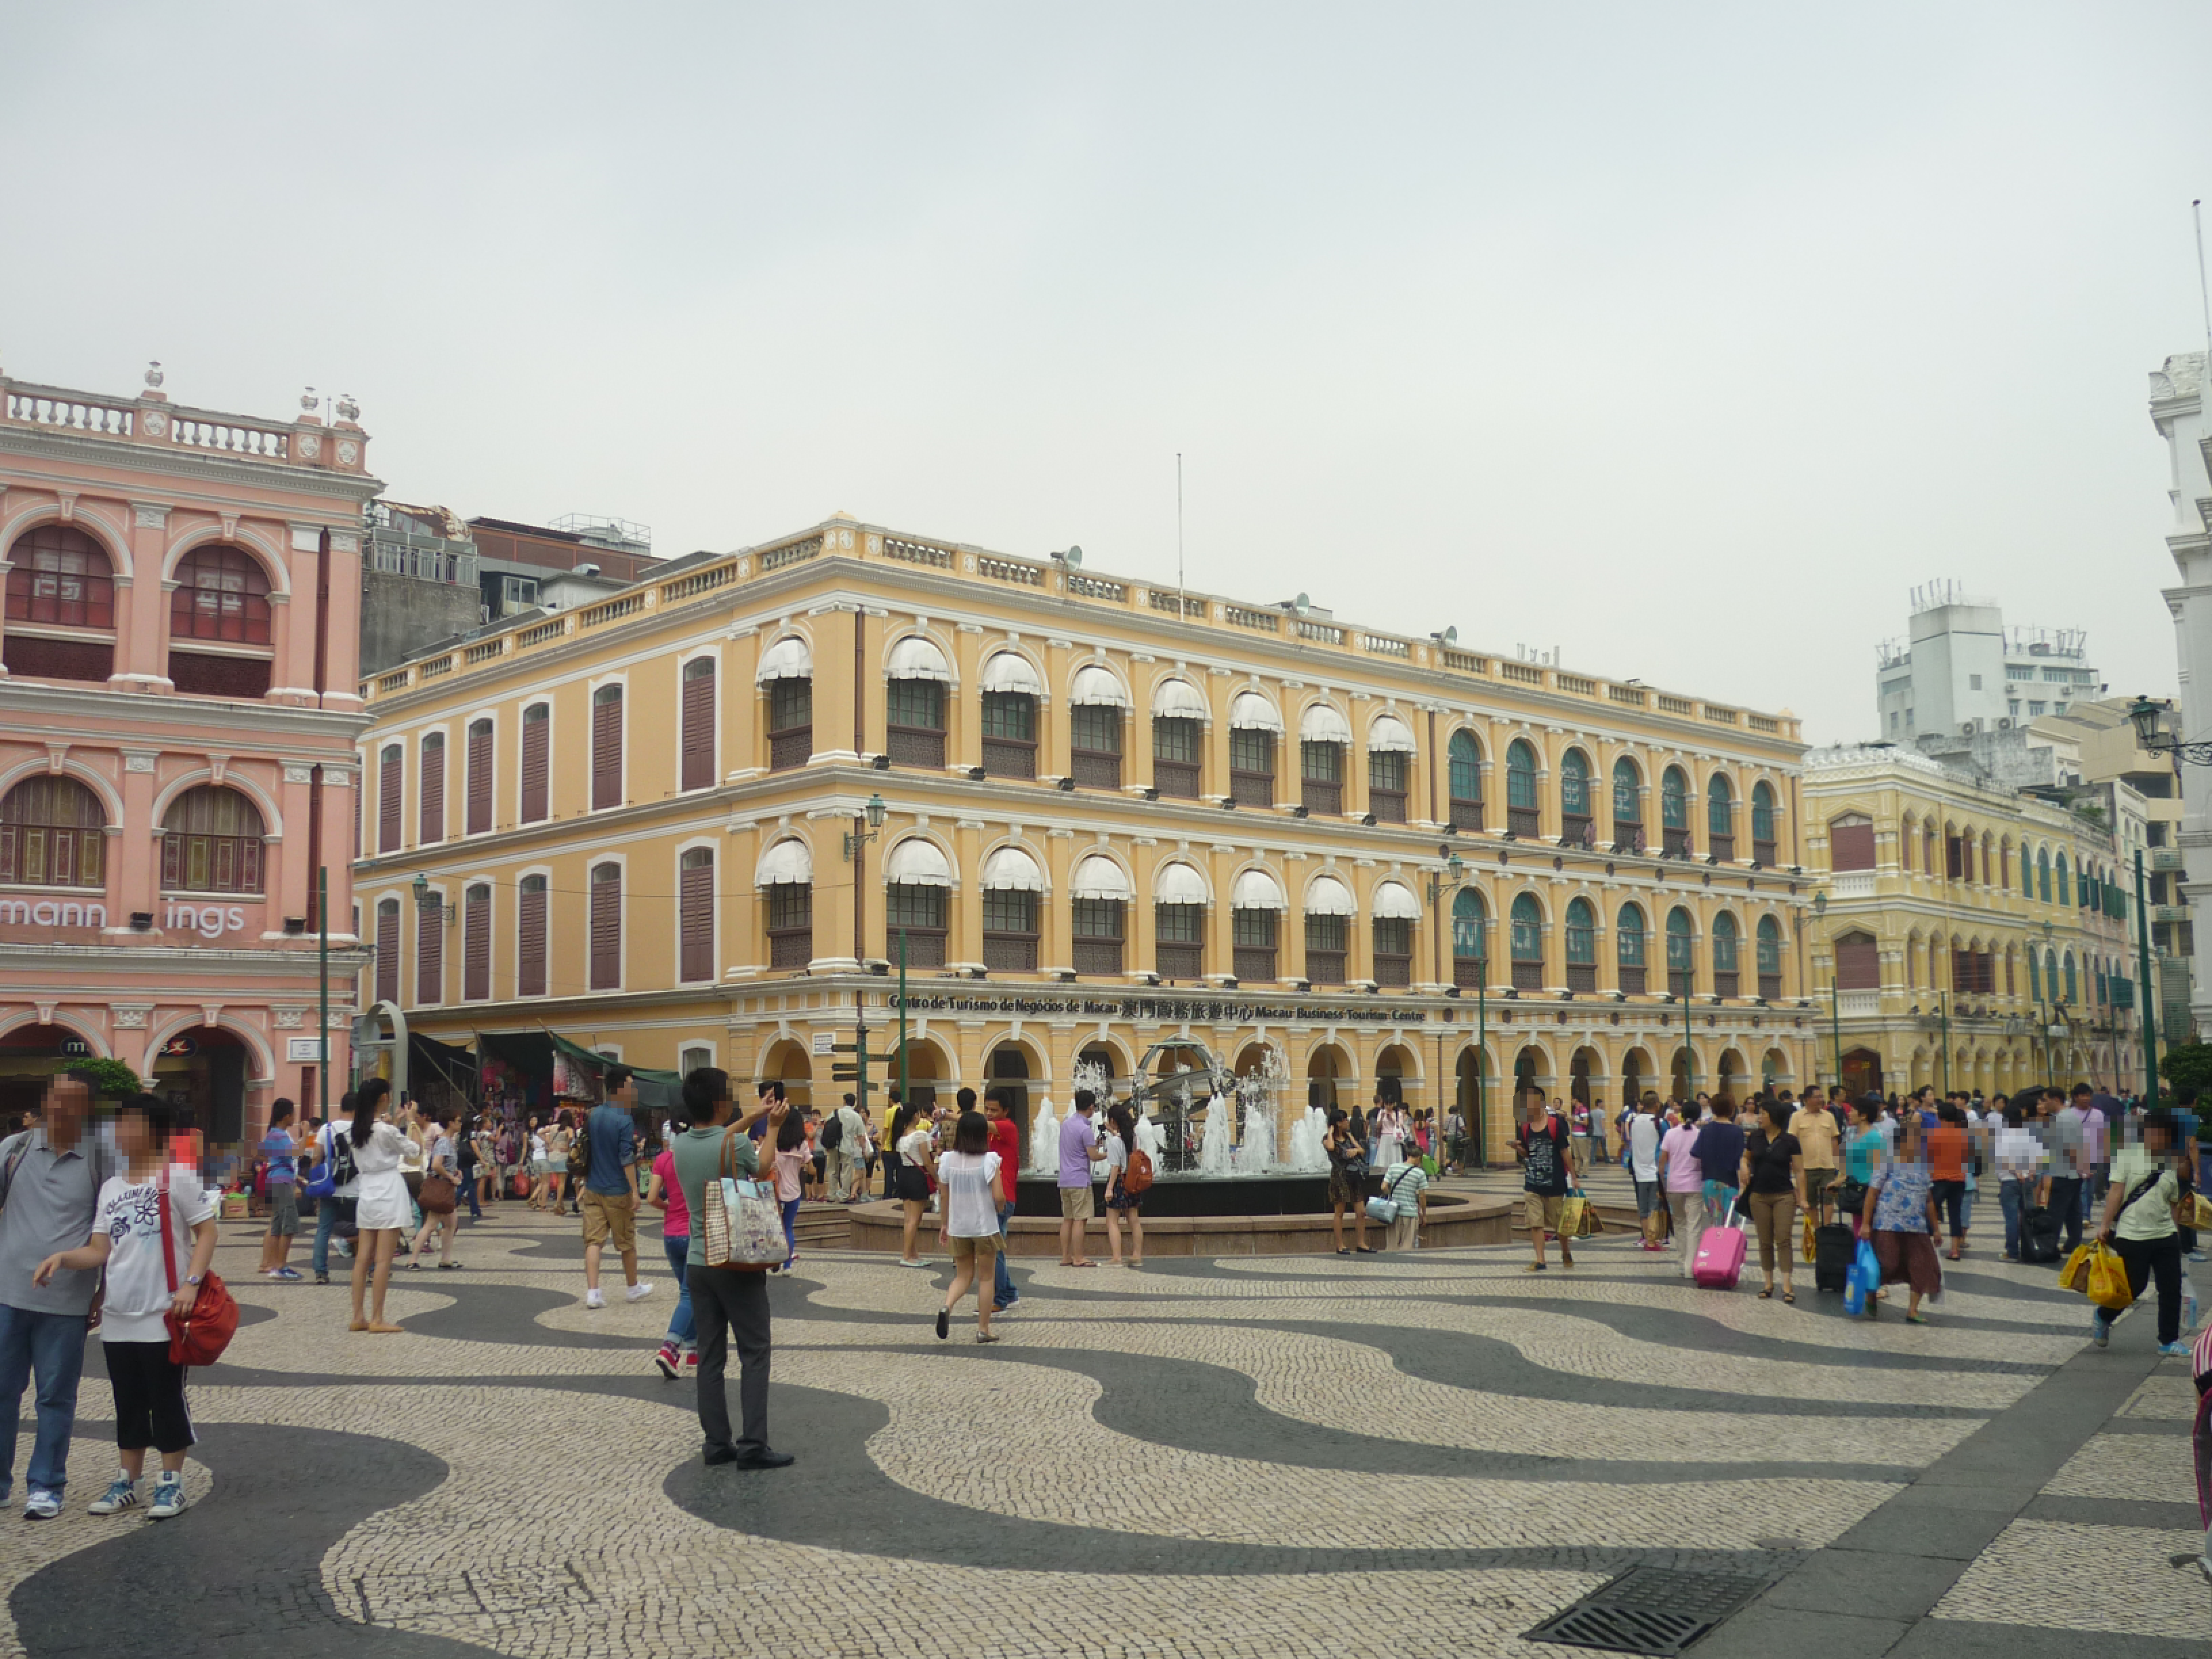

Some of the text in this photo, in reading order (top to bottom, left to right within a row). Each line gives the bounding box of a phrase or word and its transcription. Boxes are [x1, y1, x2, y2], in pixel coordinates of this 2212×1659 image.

[930, 995, 945, 1009] de
[947, 996, 998, 1010] Turismo
[1000, 998, 1015, 1011] de
[1016, 998, 1064, 1014] Negócios
[1066, 1000, 1080, 1012] de
[1084, 1000, 1118, 1013] Macau
[1255, 1006, 1292, 1019] Macau
[1296, 1007, 1344, 1019] Business
[1347, 1009, 1387, 1020] Tourism
[1391, 1009, 1425, 1021] Centre
